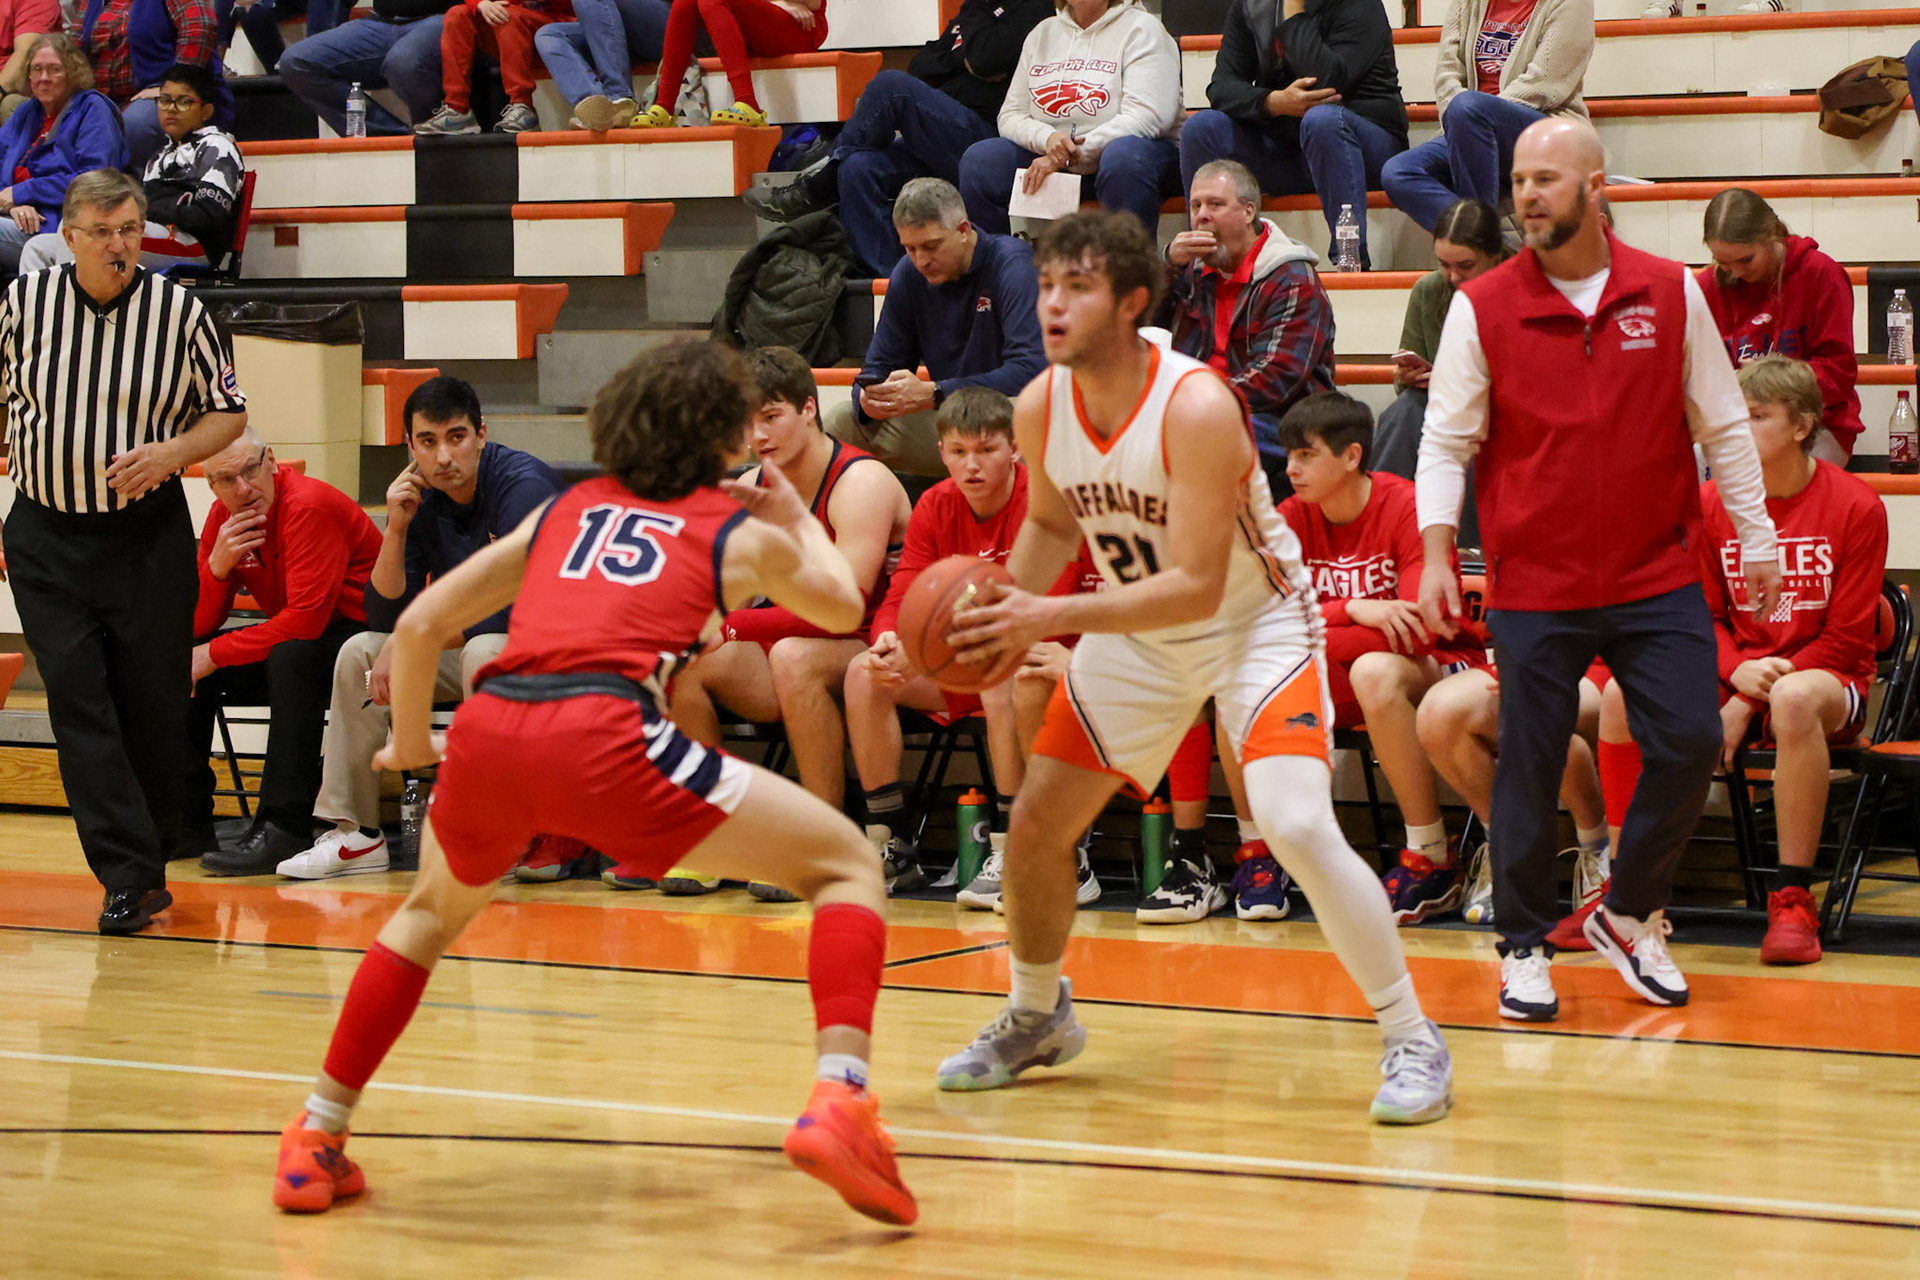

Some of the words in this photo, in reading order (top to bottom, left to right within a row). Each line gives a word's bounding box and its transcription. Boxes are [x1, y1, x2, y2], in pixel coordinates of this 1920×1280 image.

[195, 187, 232, 212] Reebo
[558, 502, 686, 587] 15
[1095, 532, 1161, 586] 21
[1720, 544, 1834, 578] ELES
[1307, 559, 1399, 599] AGLES
